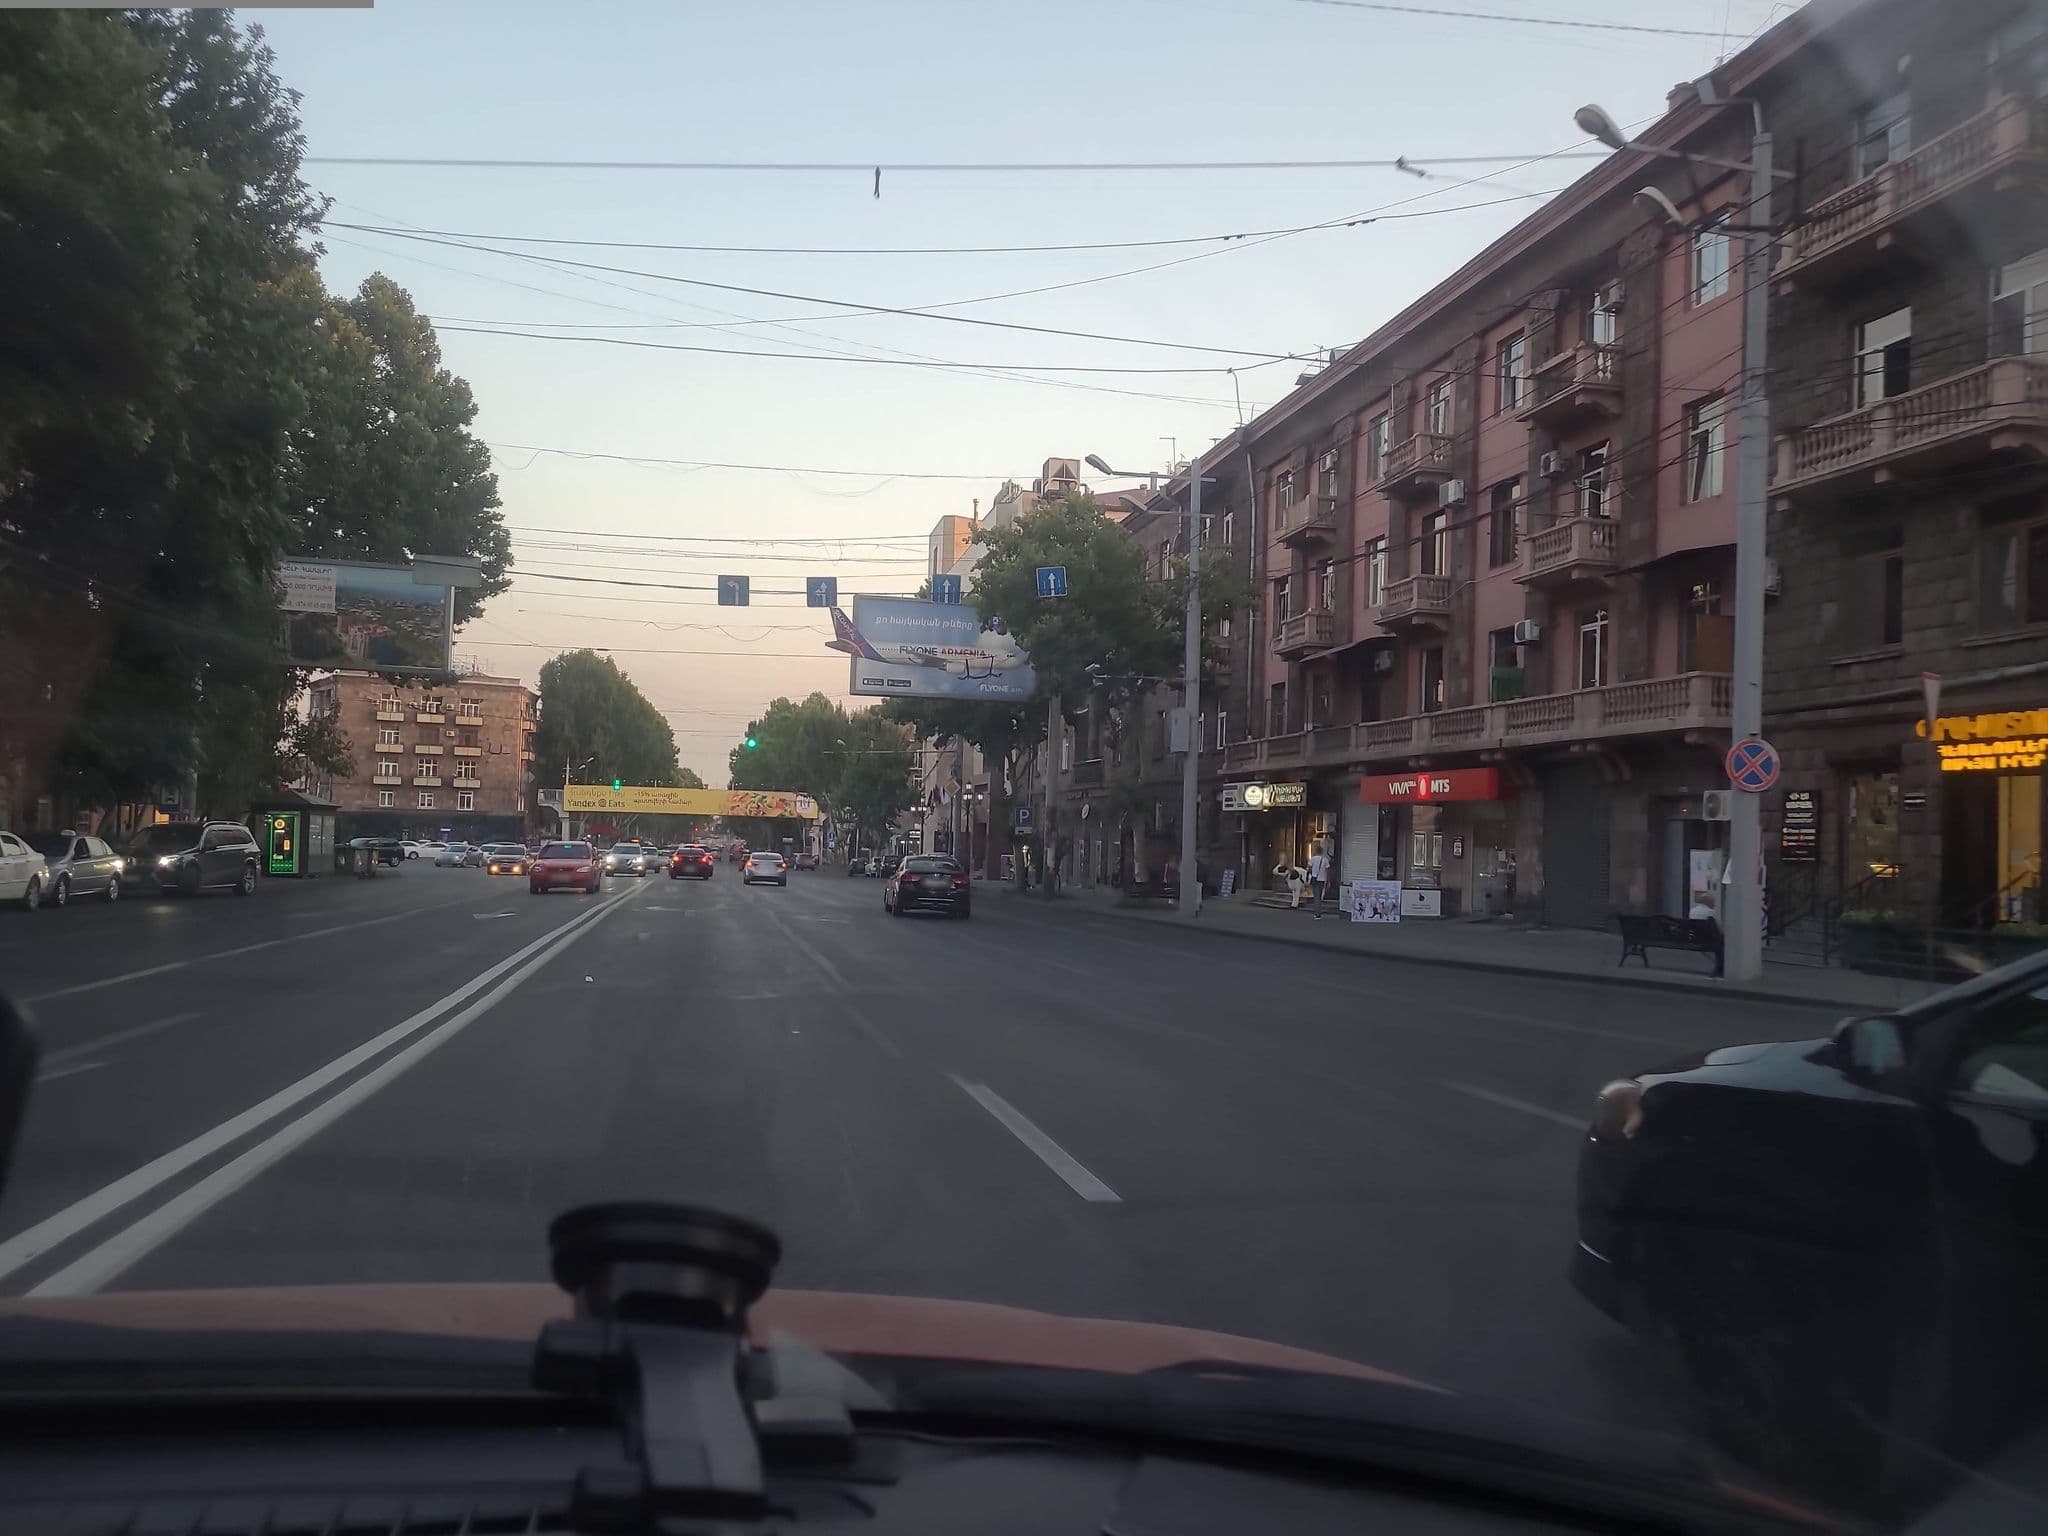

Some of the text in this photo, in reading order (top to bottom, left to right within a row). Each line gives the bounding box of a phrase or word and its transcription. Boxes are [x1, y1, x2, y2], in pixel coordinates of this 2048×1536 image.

[875, 616, 887, 625] քո
[890, 615, 939, 628] հայկական
[1431, 779, 1450, 793] MTS
[568, 799, 626, 808] Yandex Eats
[1020, 809, 1029, 823] P
